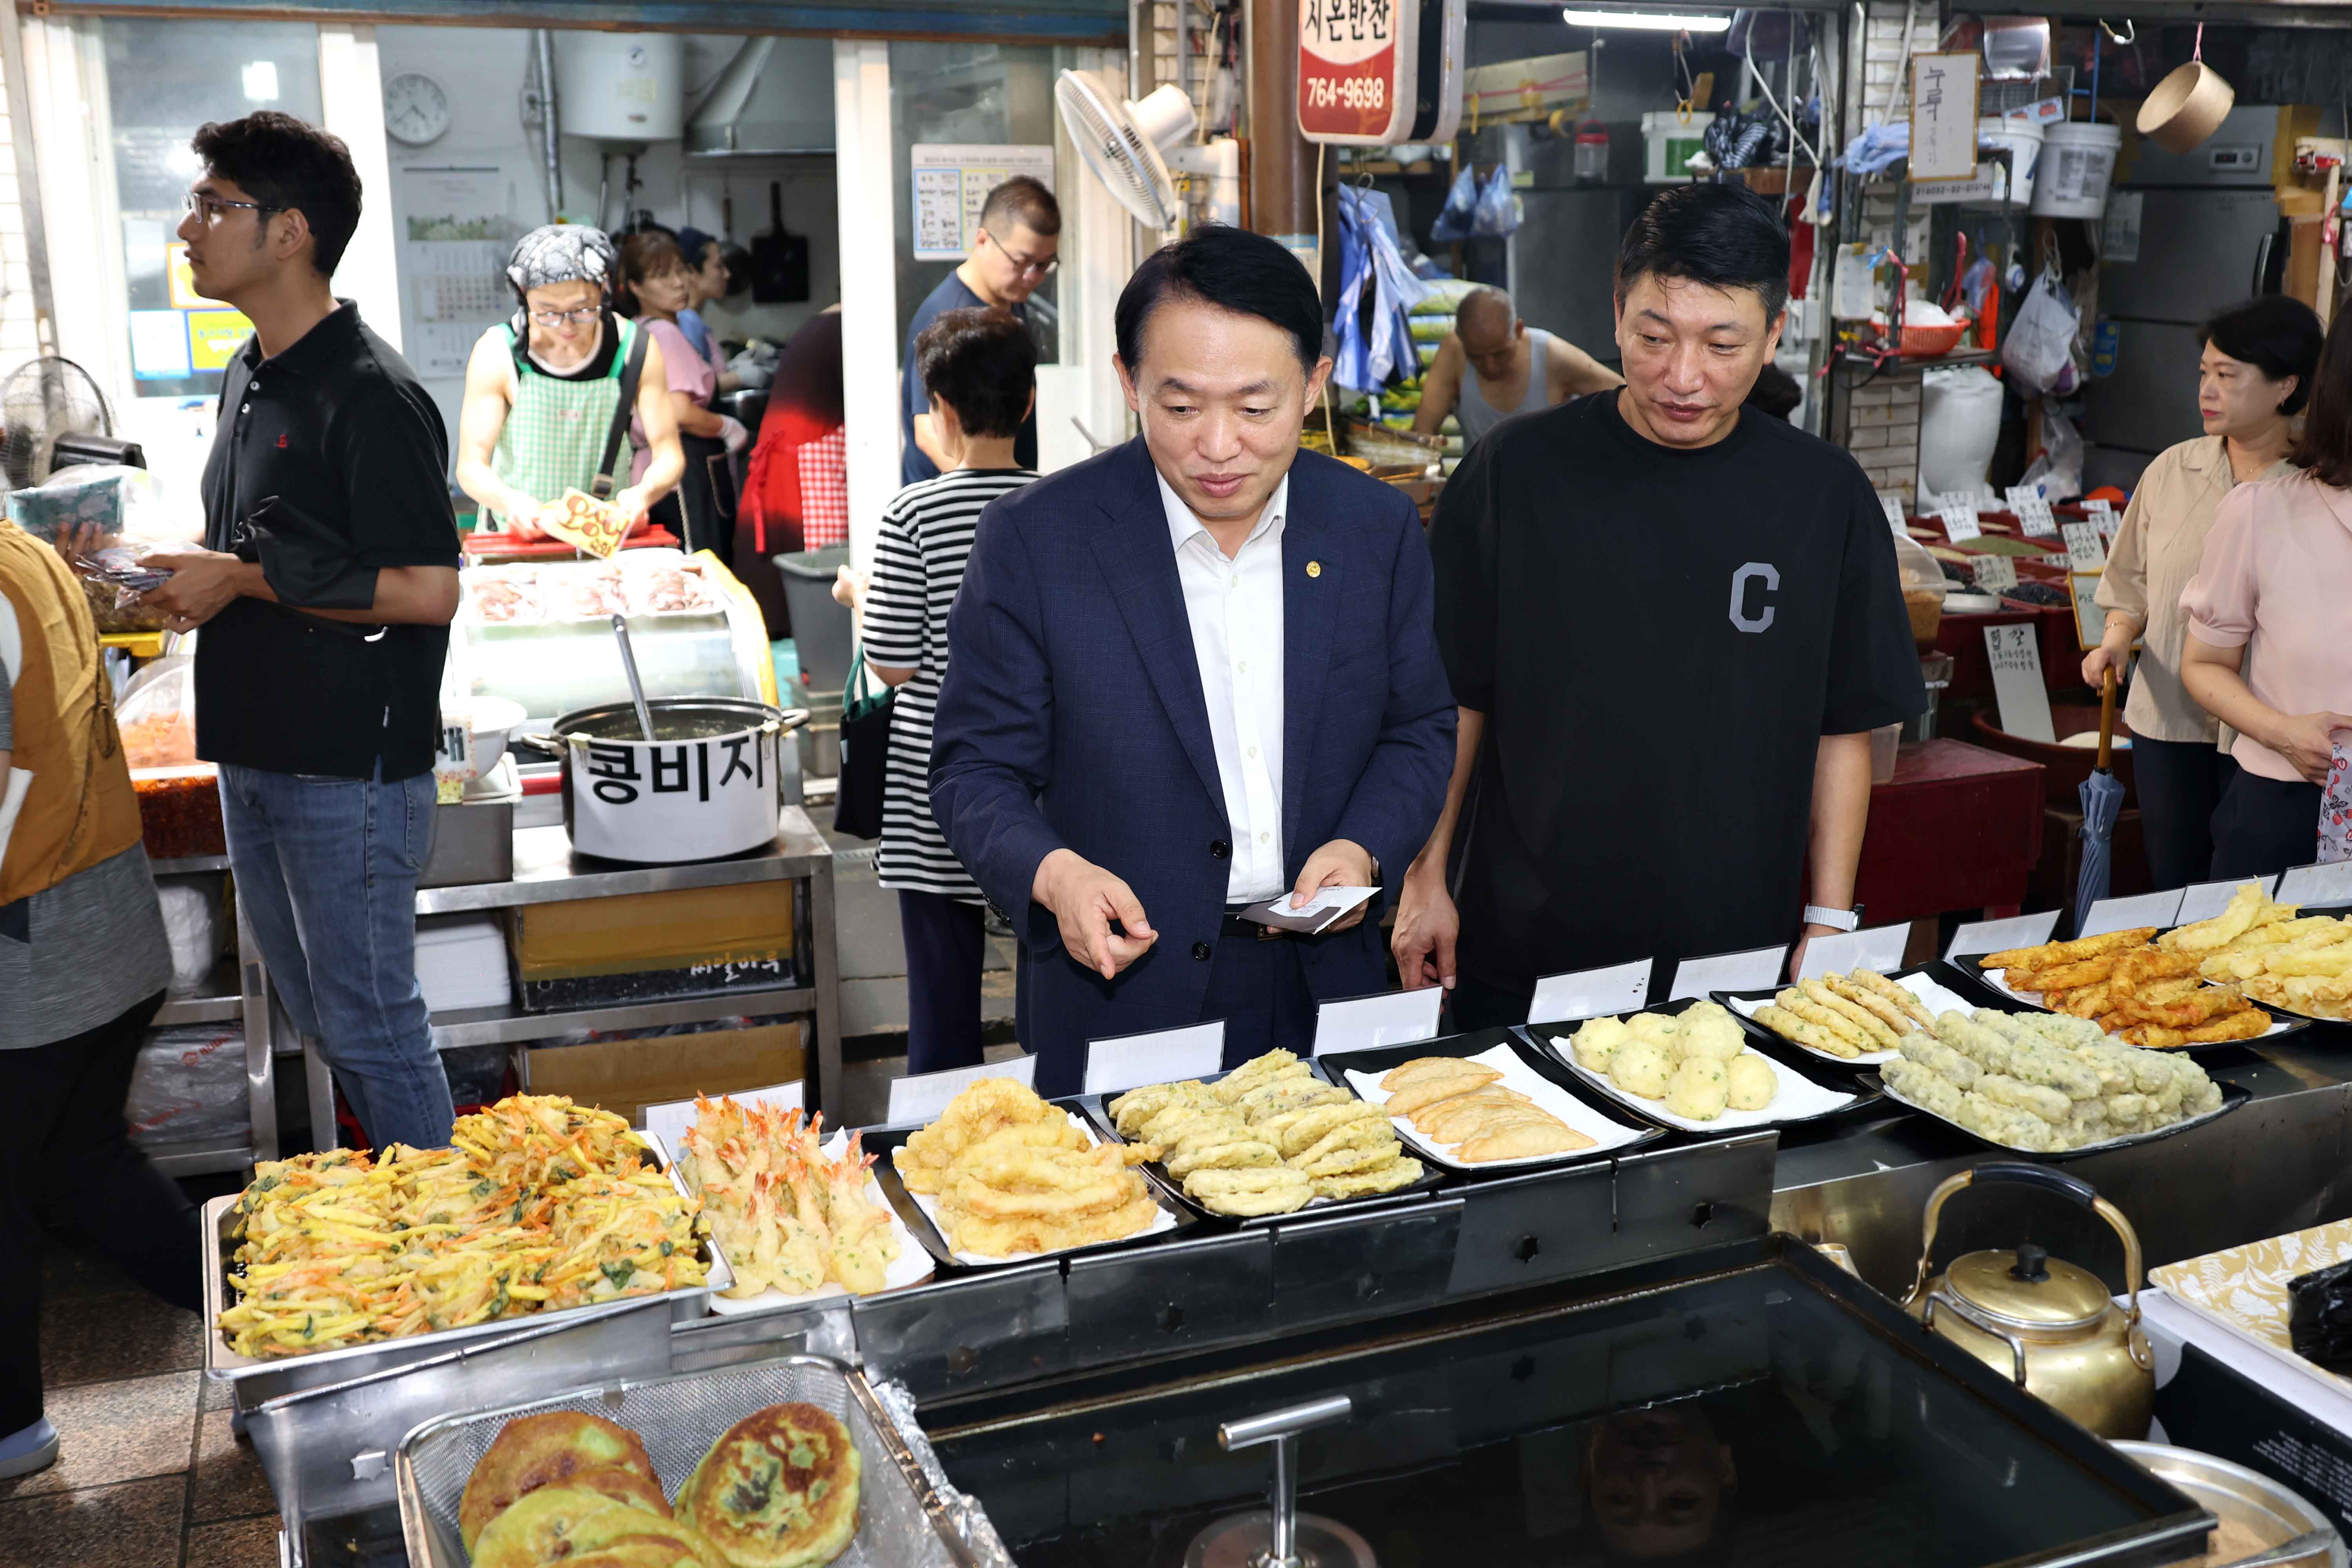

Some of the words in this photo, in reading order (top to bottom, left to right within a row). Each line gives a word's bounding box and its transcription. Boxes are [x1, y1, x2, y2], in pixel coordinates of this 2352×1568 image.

[1307, 77, 1385, 109] 764-9698
[1729, 562, 1780, 633] C
[588, 731, 763, 804] 콩비지
